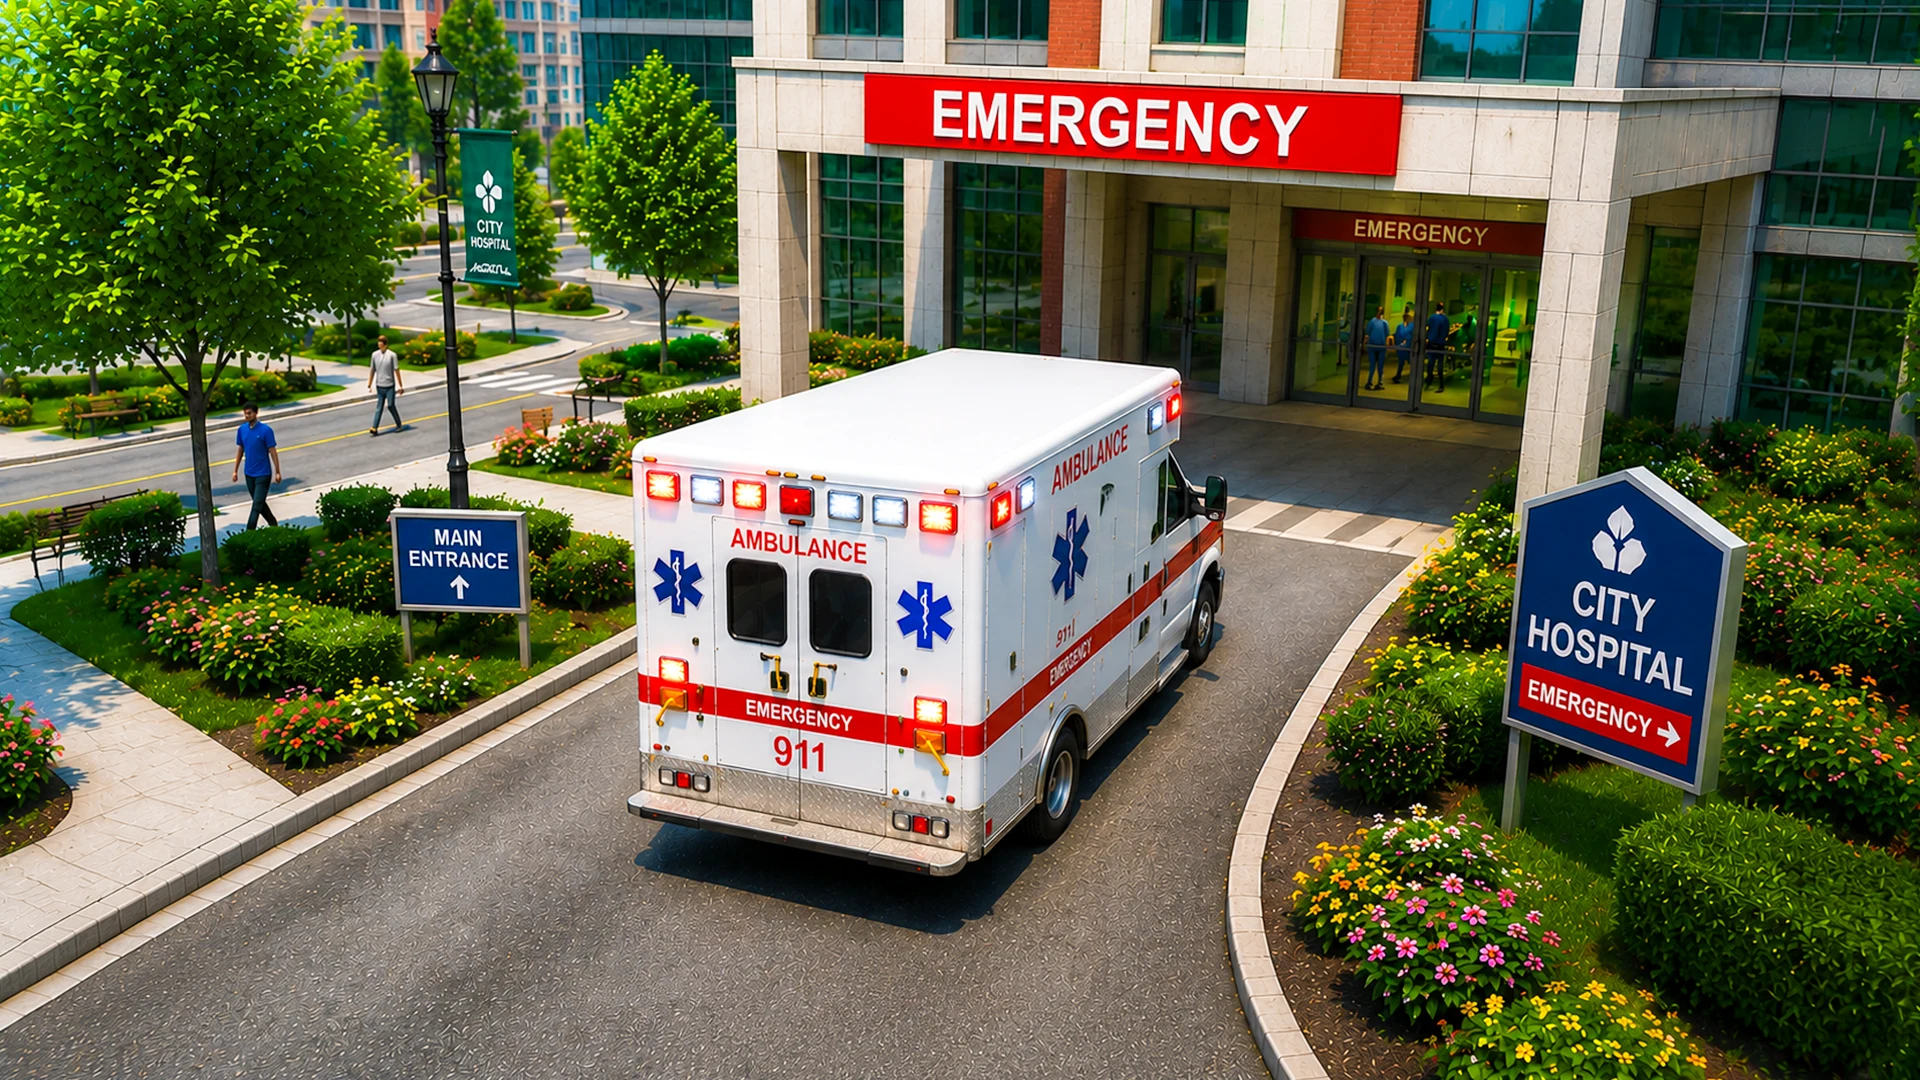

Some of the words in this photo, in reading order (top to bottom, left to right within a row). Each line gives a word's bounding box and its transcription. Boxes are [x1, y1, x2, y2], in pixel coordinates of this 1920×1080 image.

[933, 89, 1308, 157] EMERGENCY
[470, 235, 512, 251] HOSPITAL
[476, 218, 504, 236] CITY
[1354, 218, 1489, 246] EMERGENCY
[1051, 424, 1129, 495] AMBULANCE
[434, 528, 482, 547] MAIN
[730, 527, 868, 565] AMBULANCE
[408, 549, 510, 570] ENTRANCE
[1572, 580, 1656, 633] CITY
[1527, 614, 1694, 697] HOSPITAL
[745, 699, 853, 732] EMERGENCY
[1527, 678, 1653, 738] EMERGENCY
[772, 734, 825, 773] 911
